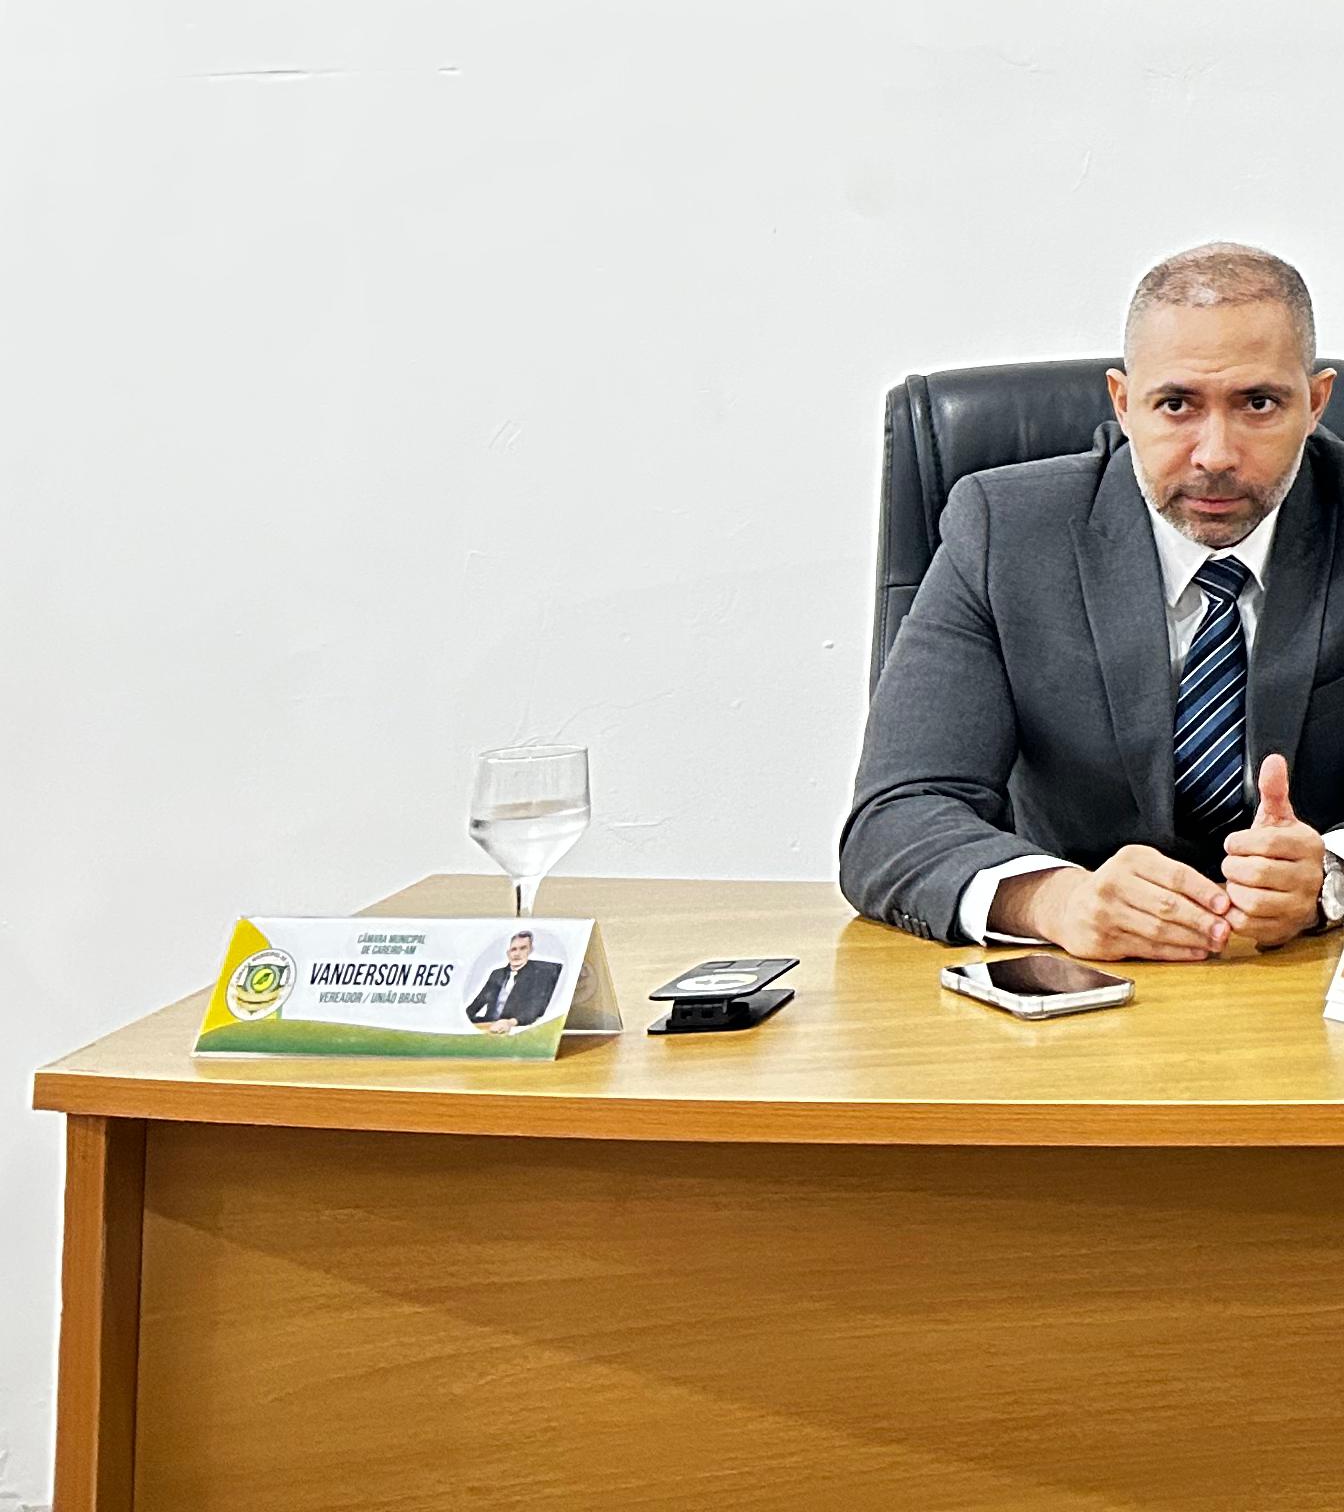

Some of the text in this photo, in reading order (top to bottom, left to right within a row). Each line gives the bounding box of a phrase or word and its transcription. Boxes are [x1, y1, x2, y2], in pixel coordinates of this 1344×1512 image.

[309, 962, 412, 986] VANDERSON
[412, 963, 454, 987] REIS
[319, 991, 363, 1004] VEREADOR
[397, 992, 427, 1005] BRASIL
